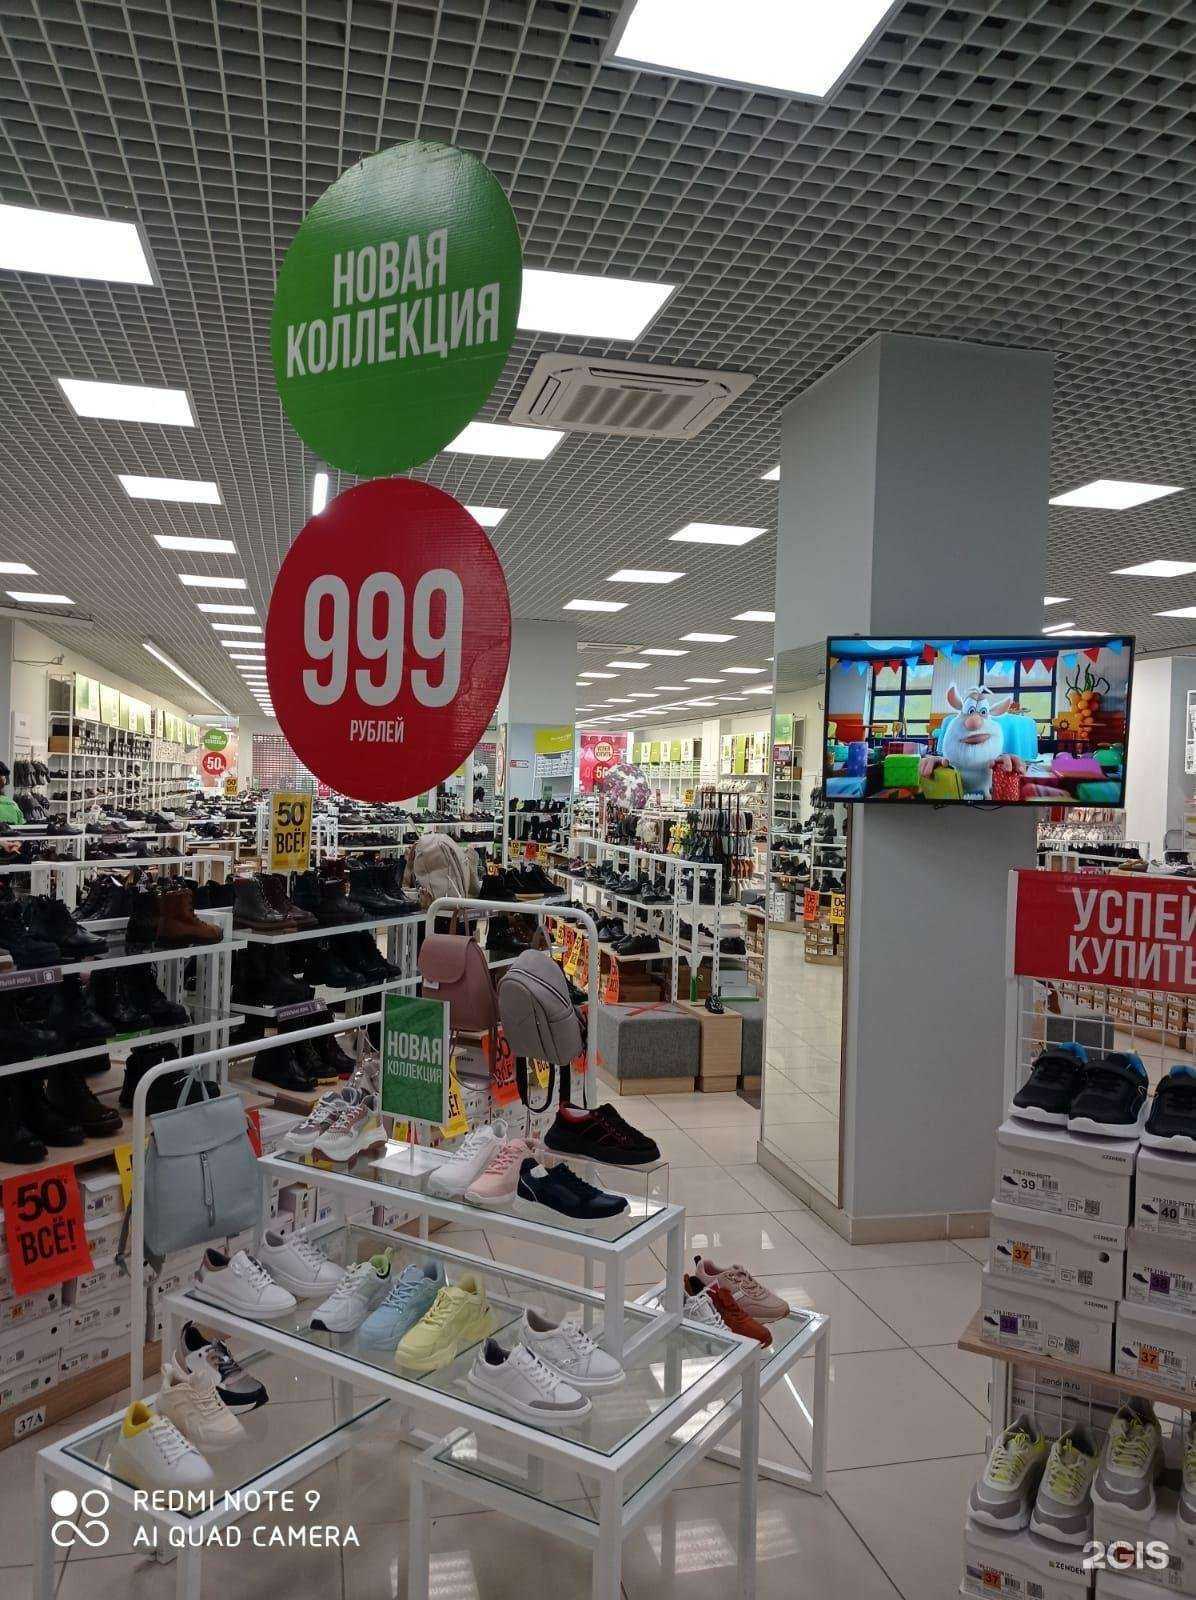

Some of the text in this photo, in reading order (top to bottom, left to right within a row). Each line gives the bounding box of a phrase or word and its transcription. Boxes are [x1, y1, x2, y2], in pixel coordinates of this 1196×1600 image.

[333, 227, 448, 309] НОВАЯ
[285, 282, 500, 378] КОЛЛЕКЦИЯ
[302, 568, 464, 708] 999
[349, 716, 404, 744] РУБЛЕЙ
[276, 828, 307, 854] ВСЁ!
[387, 1030, 442, 1066] НОВАЯ
[387, 1060, 442, 1084] КОЛЛЕКЦИЯ
[1021, 1178, 1035, 1190] 39
[1161, 1206, 1178, 1219] 40
[18, 1216, 76, 1266] ВСЁ!
[1014, 1249, 1030, 1260] 37
[1141, 1352, 1157, 1364] 37
[984, 1572, 999, 1585] 37
[1055, 1561, 1086, 1576] ZENDEN
